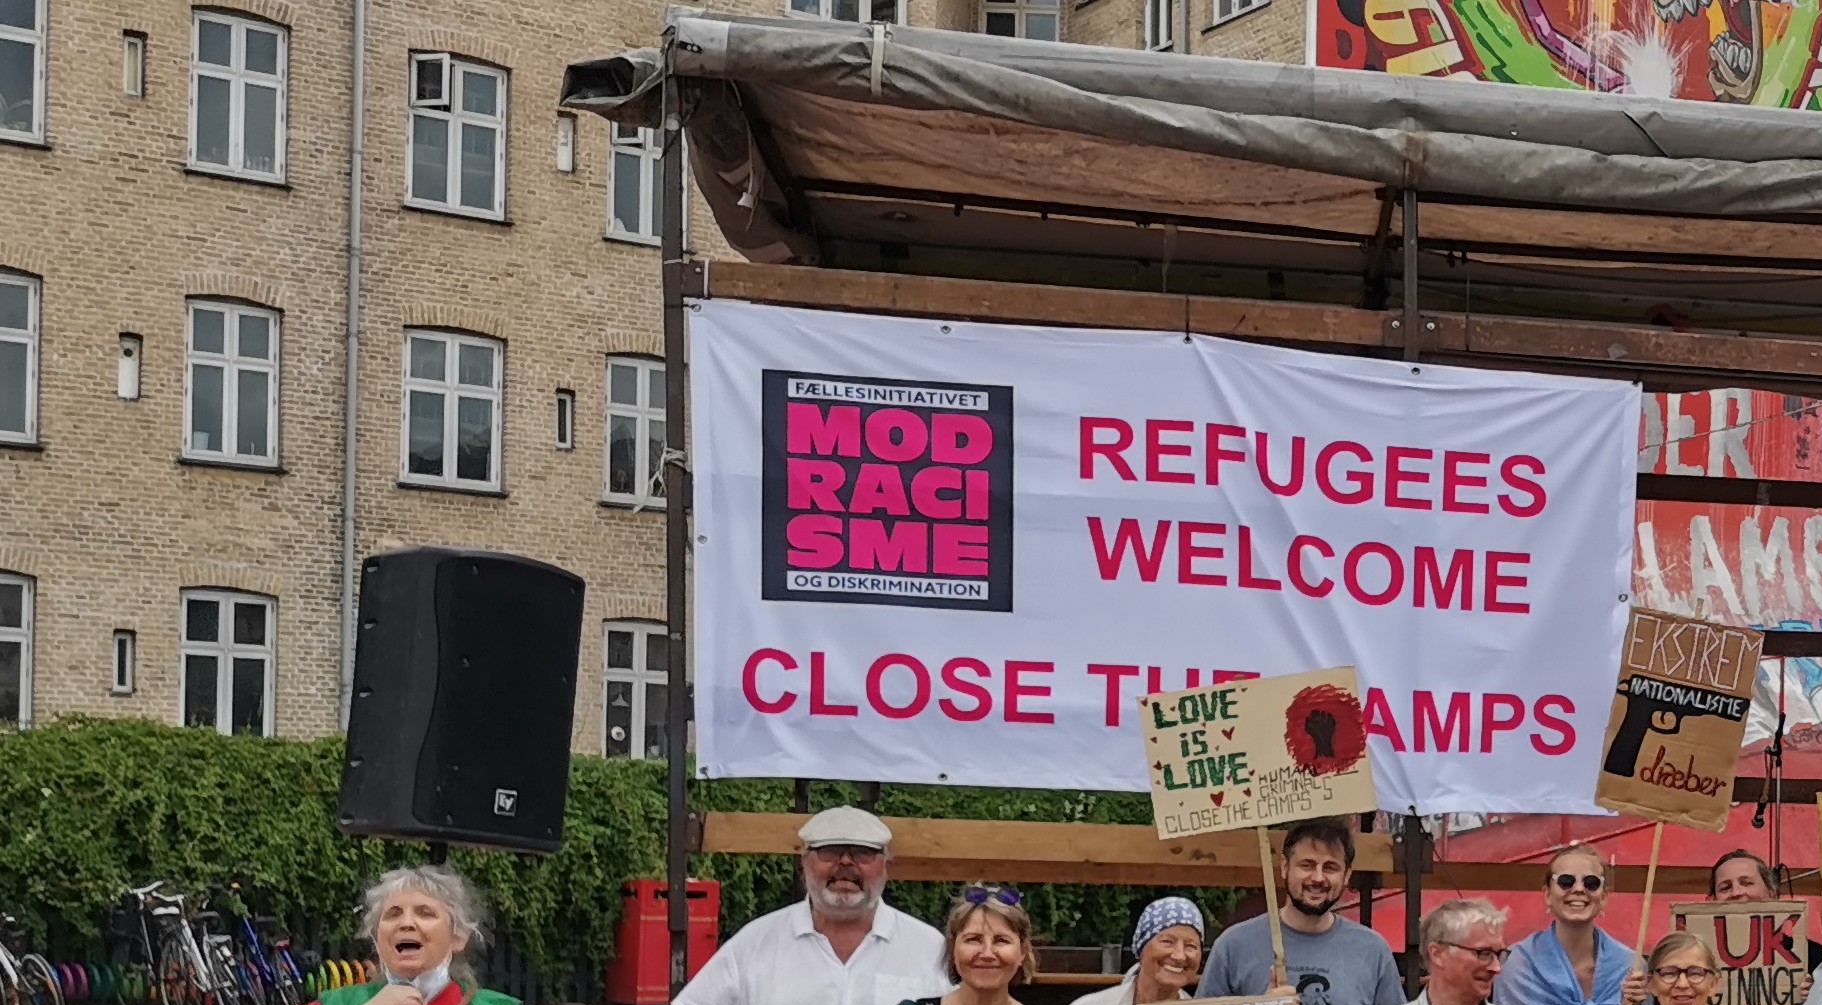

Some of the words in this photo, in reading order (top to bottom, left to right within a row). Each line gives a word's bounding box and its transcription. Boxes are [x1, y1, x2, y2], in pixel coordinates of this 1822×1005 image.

[795, 382, 981, 406] FÆLLESINITIATIVET
[787, 402, 993, 464] MOD
[787, 458, 989, 520] RACI
[1079, 415, 1547, 518] REFUGEES
[786, 514, 989, 576] SME
[1087, 516, 1533, 615] WELCOME
[794, 575, 822, 588] OG
[828, 576, 981, 597] DISKRIMINATION
[1627, 613, 1764, 691] EKSTREM
[742, 647, 1054, 725] CLOSE
[1362, 687, 1578, 757] AMPS
[1152, 688, 1239, 729] LOVE
[1630, 677, 1745, 718] NATIONALISME
[1164, 752, 1252, 791] LOVE
[1639, 745, 1727, 797] dræber
[1165, 805, 1223, 835] CLOSE
[1223, 800, 1252, 826] THE
[1257, 790, 1312, 819] CAMPS
